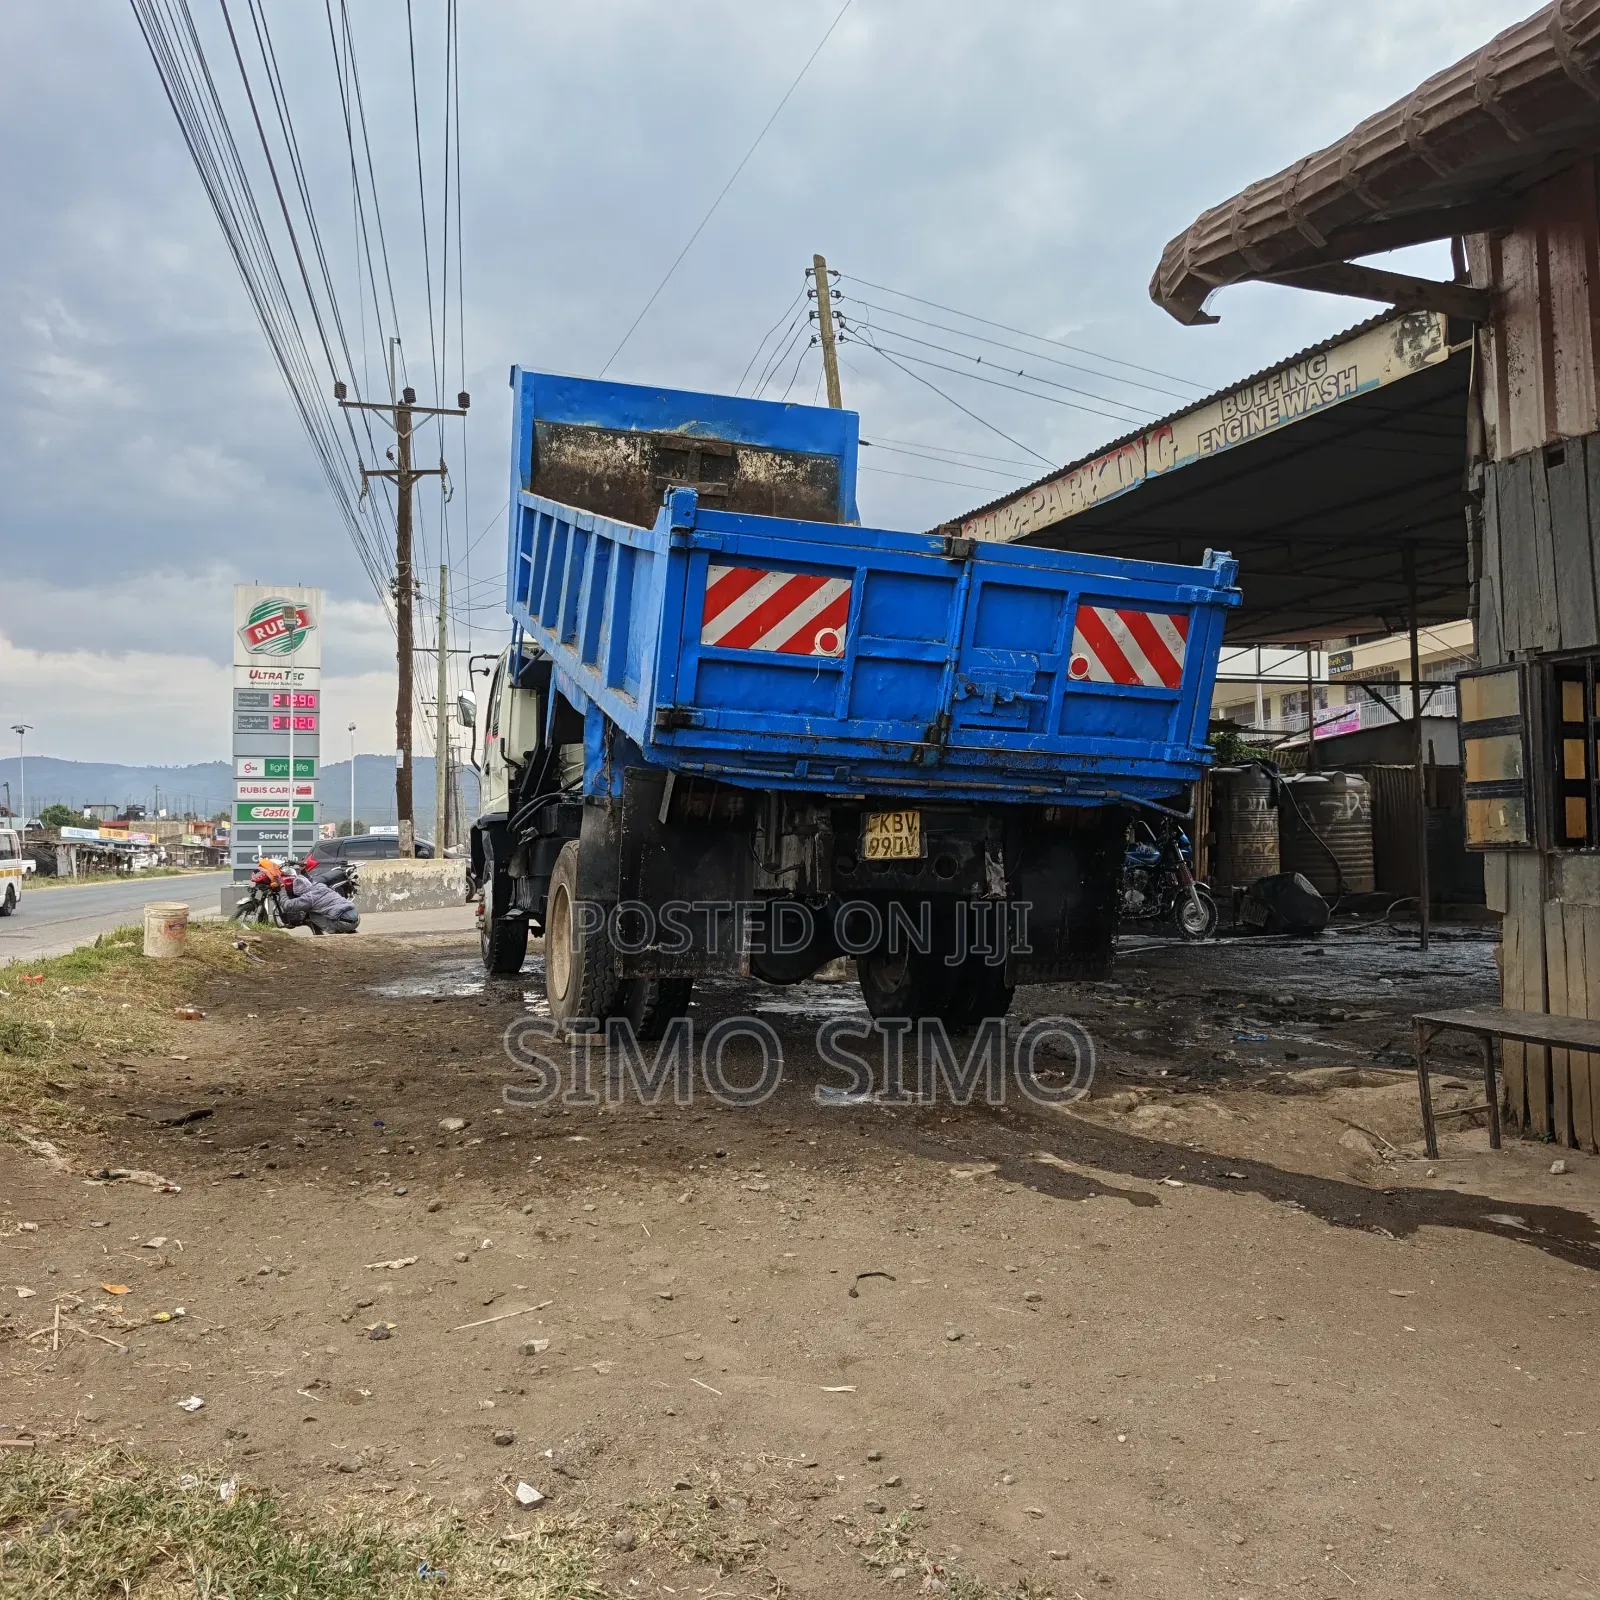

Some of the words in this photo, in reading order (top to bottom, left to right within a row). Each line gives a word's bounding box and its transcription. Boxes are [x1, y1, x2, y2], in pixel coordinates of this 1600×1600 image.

[1220, 354, 1328, 422] BUFFING
[1198, 400, 1280, 455] ENGINE
[1282, 365, 1358, 419] WASH
[1027, 424, 1178, 517] PARKING
[254, 613, 303, 640] RUBS
[1342, 668, 1376, 681] COSMETICS
[269, 763, 288, 773] light
[296, 763, 309, 772] life
[262, 808, 296, 818] Castrl
[879, 813, 916, 834] KBV
[258, 831, 292, 840] Servic
